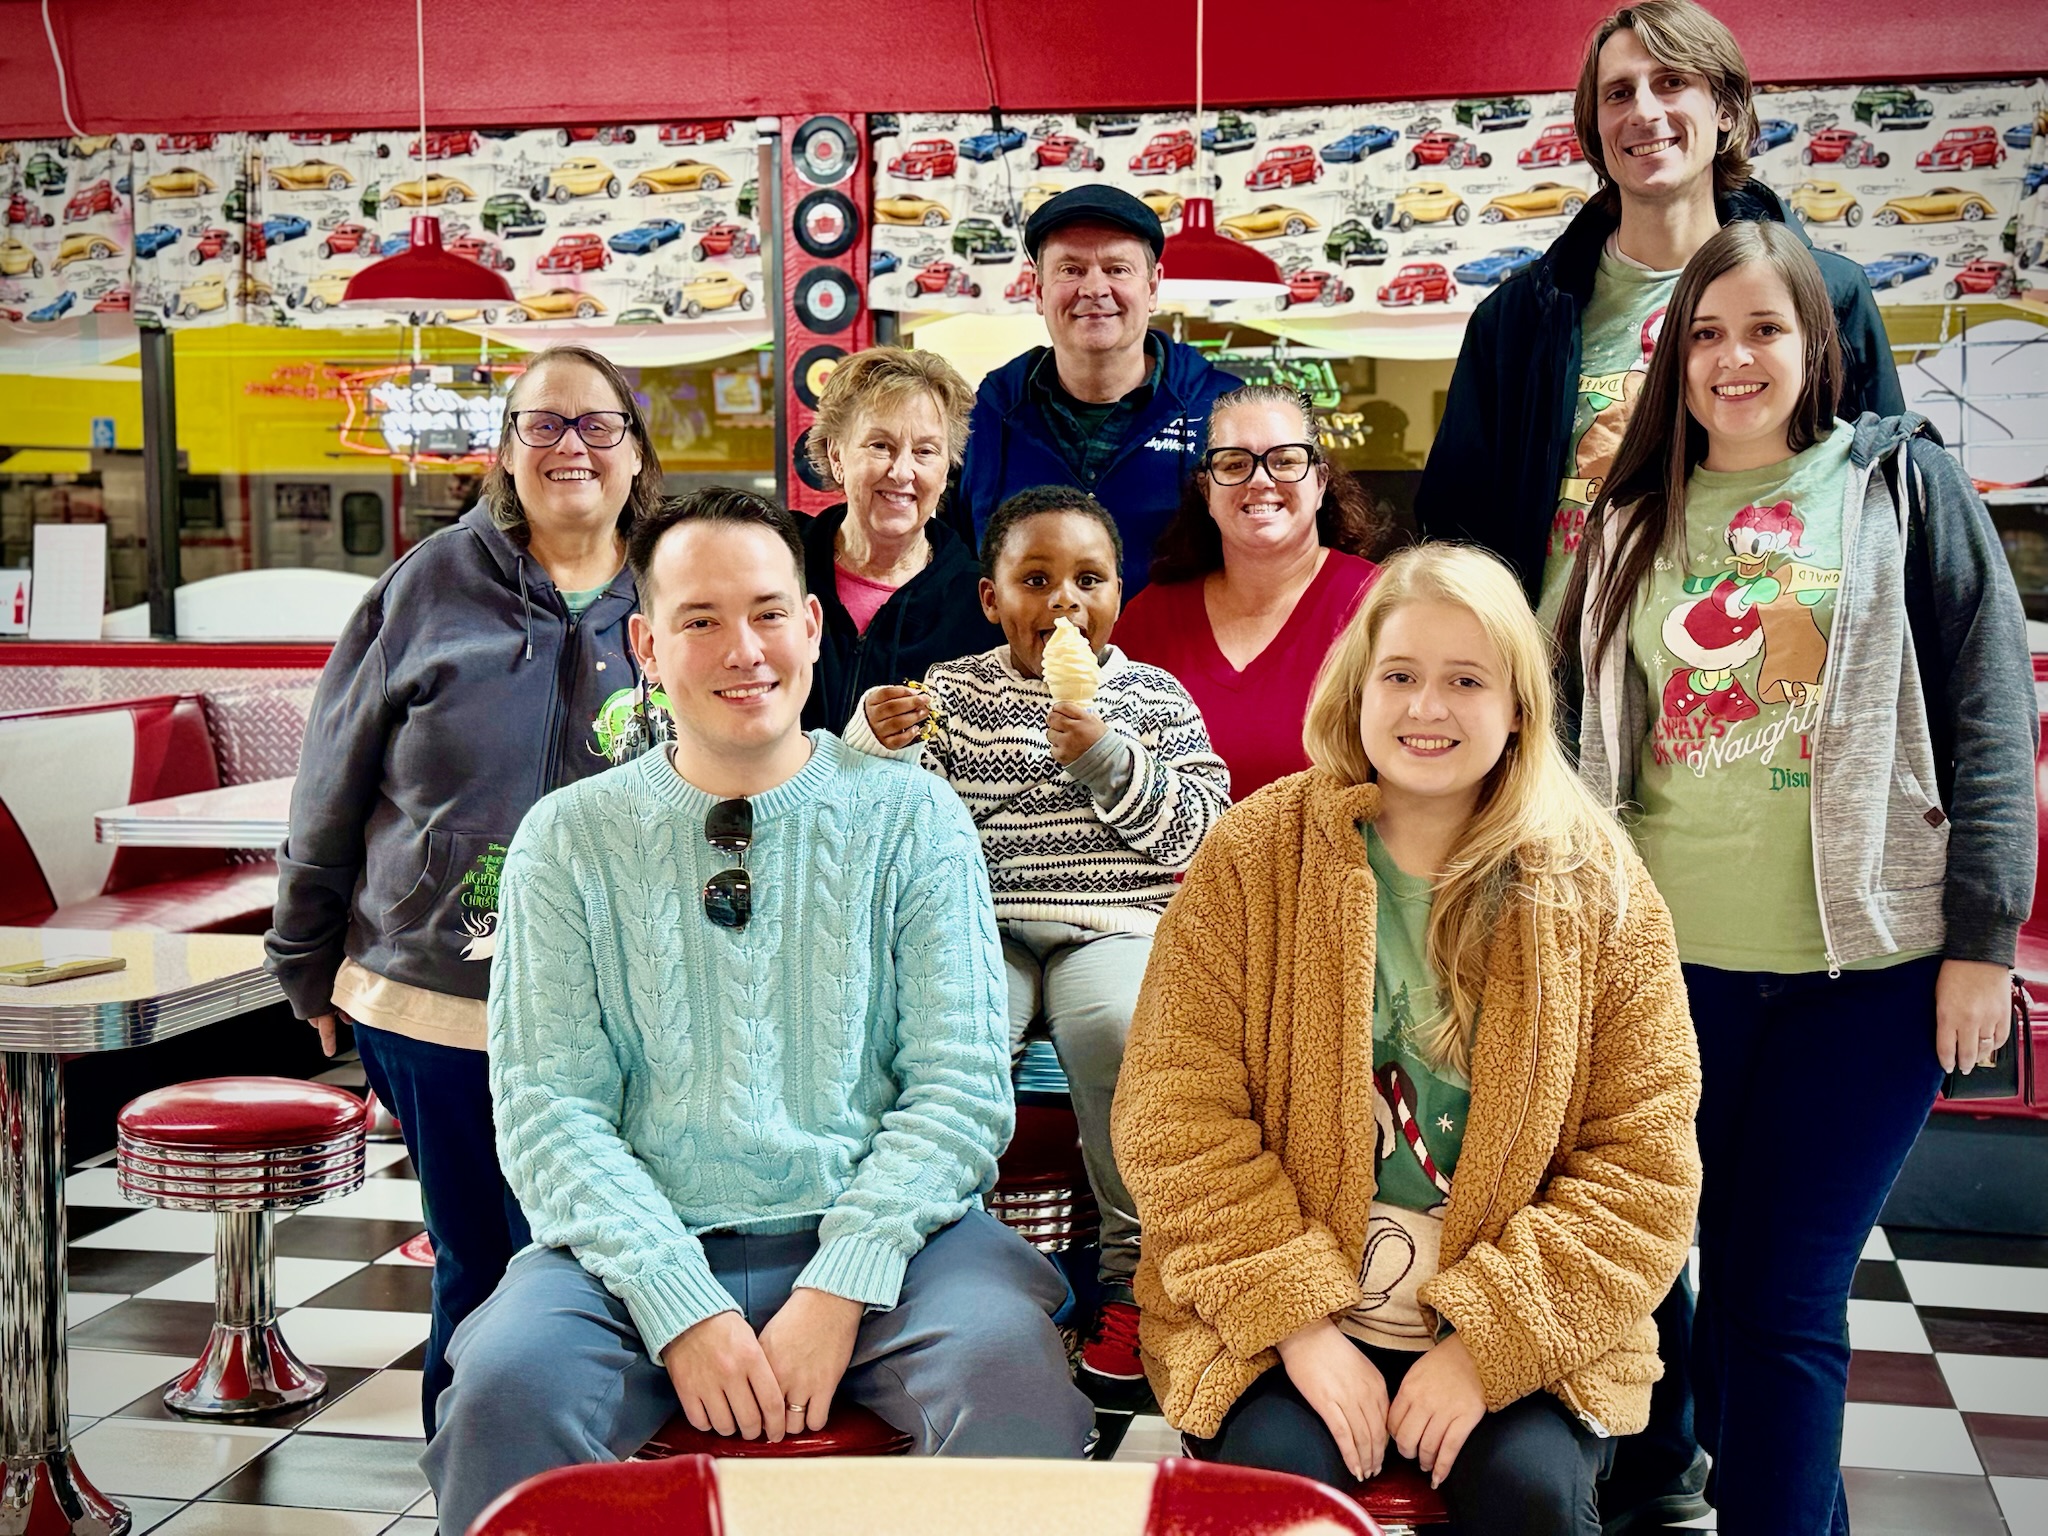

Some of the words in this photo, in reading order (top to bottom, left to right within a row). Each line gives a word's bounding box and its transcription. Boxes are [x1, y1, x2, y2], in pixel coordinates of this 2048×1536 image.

[1798, 570, 1840, 583] ONALD
[1768, 767, 1810, 791] Disn
[461, 870, 500, 885] NIGHTM
[461, 892, 499, 911] CHRIST
